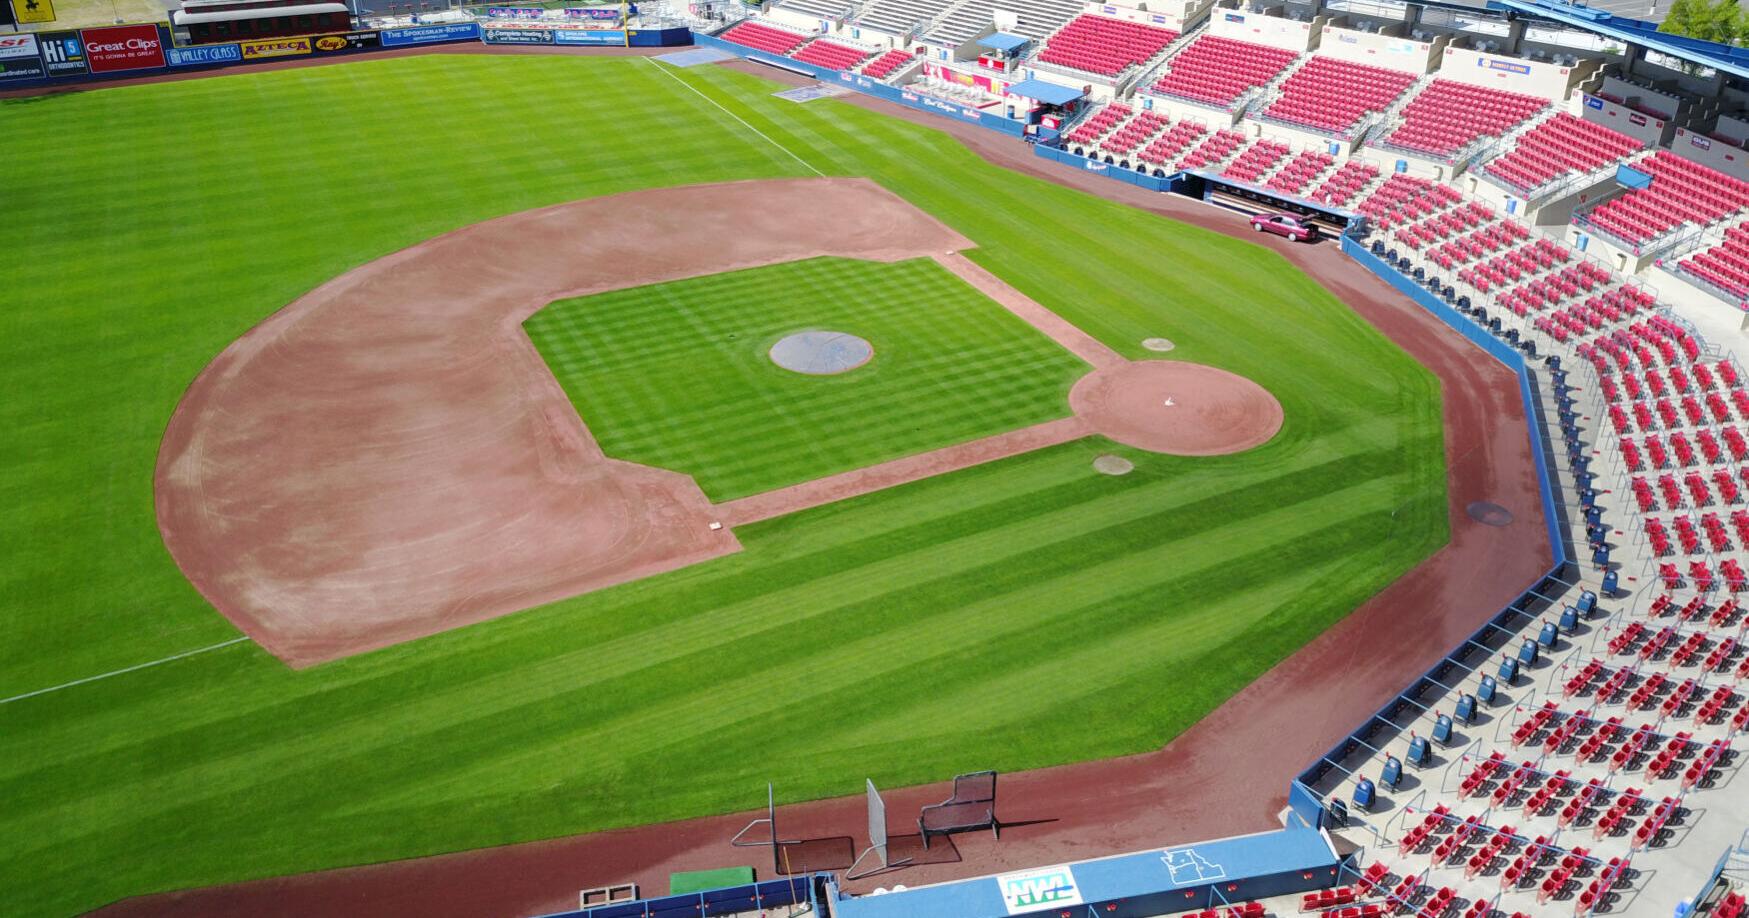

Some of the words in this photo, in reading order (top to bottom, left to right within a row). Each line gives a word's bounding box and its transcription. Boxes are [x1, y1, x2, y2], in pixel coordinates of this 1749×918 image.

[87, 42, 125, 53] Great
[126, 38, 156, 50] Clips
[245, 41, 310, 55] AZTECA
[320, 36, 345, 49] Ray's
[42, 40, 66, 62] Hi
[67, 42, 76, 53] 5
[137, 50, 156, 58] GREAT
[181, 49, 208, 62] VALLEY
[210, 46, 237, 60] GLASS
[49, 61, 85, 70] ORTHODONTICS
[1007, 875, 1075, 906] NWL
